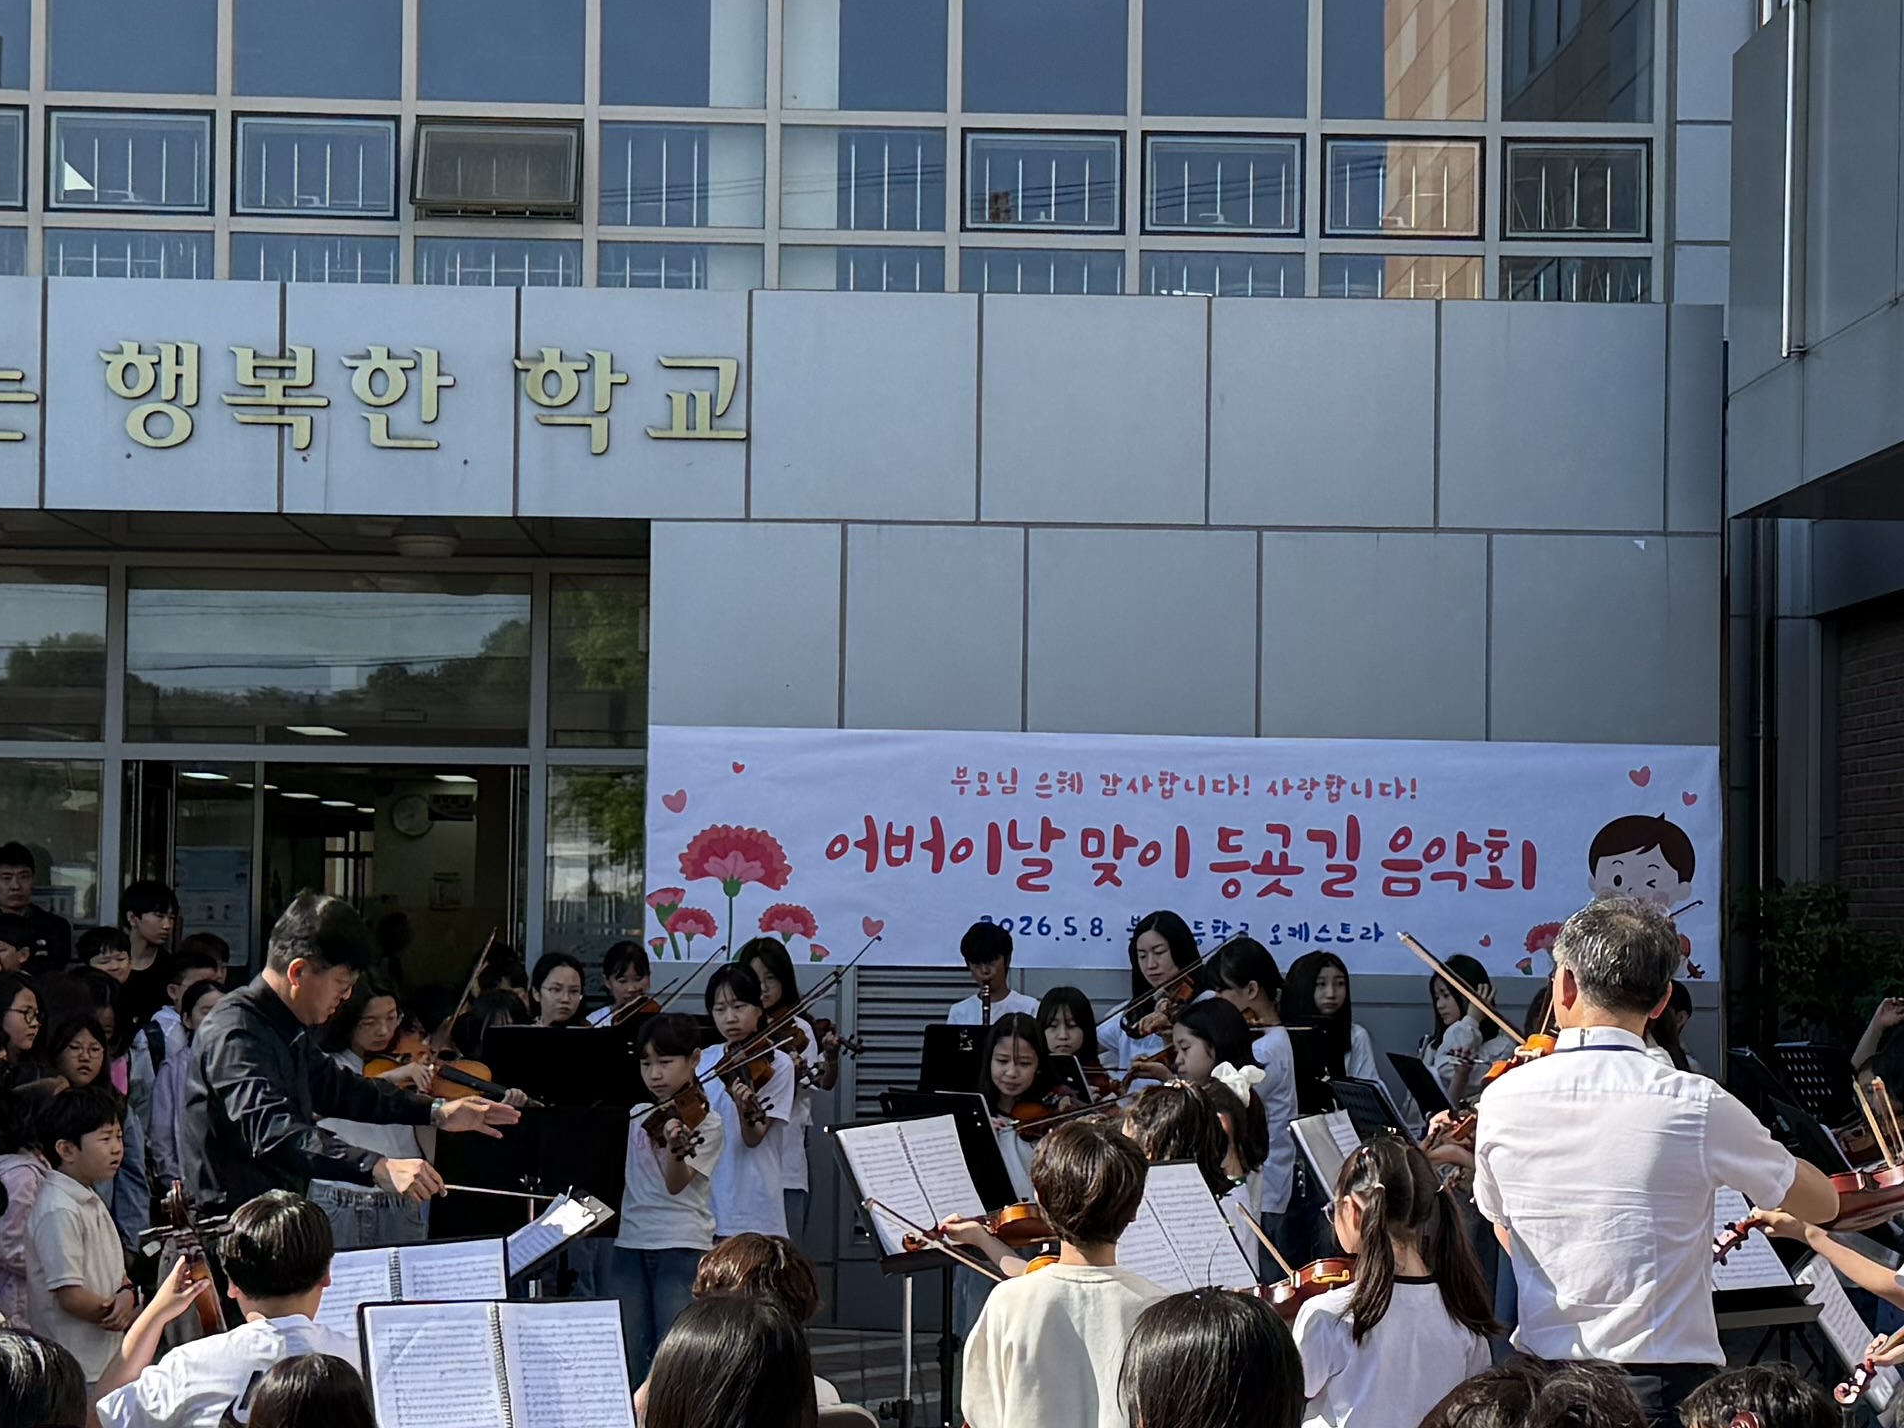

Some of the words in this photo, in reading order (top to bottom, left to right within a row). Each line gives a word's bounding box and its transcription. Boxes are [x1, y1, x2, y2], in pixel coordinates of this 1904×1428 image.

[98, 339, 456, 452] 행복한
[513, 346, 749, 456] 학교
[949, 765, 1019, 798] 부모님
[1034, 770, 1084, 800] 은혜
[1099, 770, 1251, 802] 감사합니다!
[1266, 773, 1419, 804] 사랑합니다!
[824, 814, 1067, 893] 어버이날
[1080, 822, 1191, 888] 맞이
[1208, 813, 1362, 899] 등굣길
[1379, 825, 1539, 898] 음악회
[980, 914, 1112, 943] 026.5.8.
[1268, 920, 1385, 946] 오케스트라
